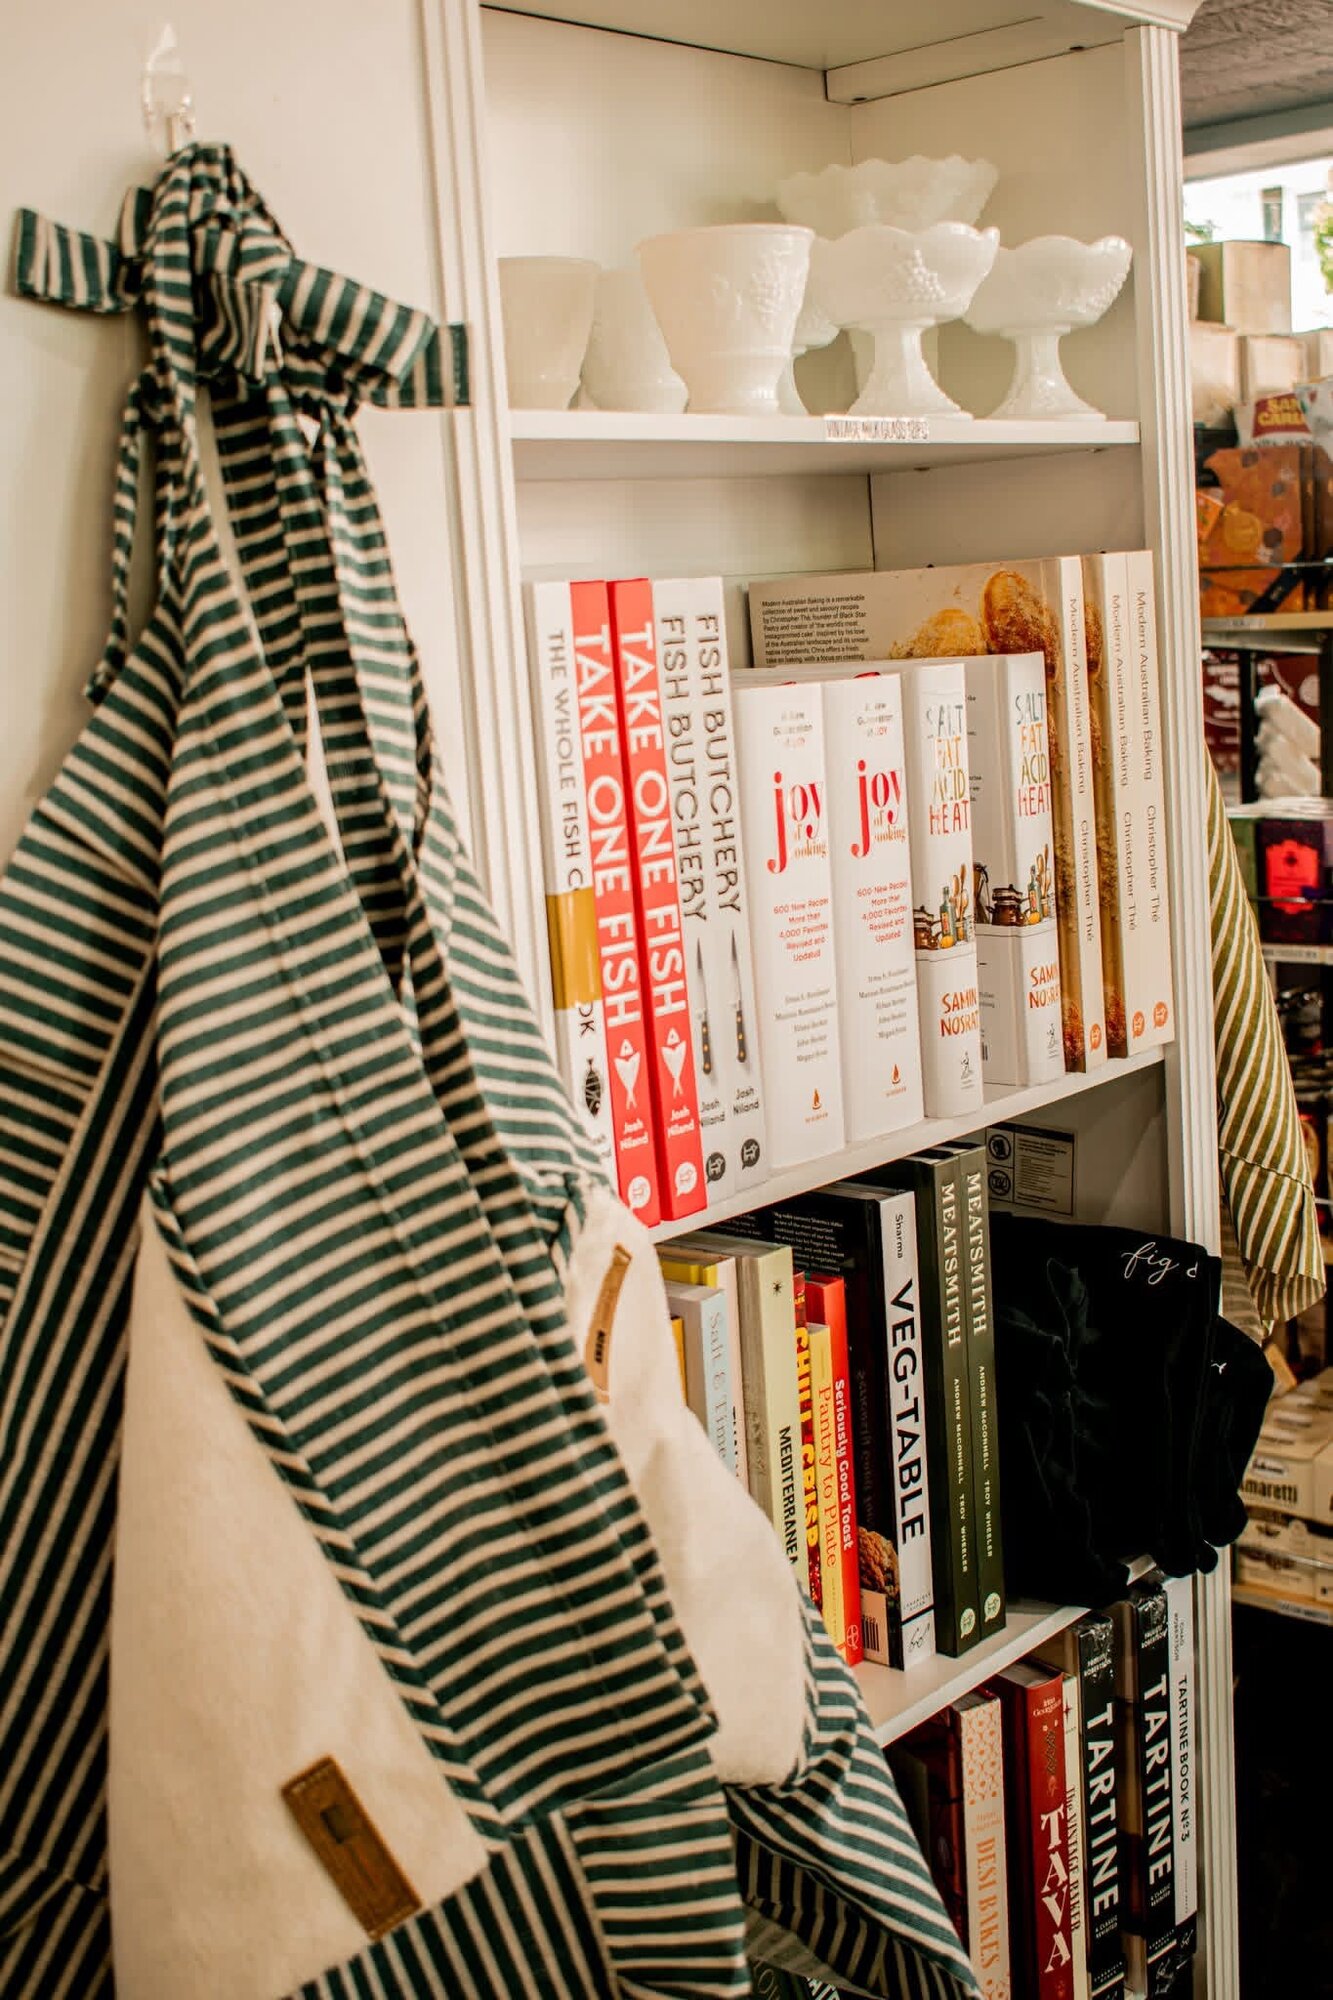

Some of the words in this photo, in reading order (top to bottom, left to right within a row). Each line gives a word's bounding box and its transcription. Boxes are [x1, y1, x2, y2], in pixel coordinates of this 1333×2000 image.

[1069, 598, 1079, 658] Modern
[1112, 594, 1122, 653] Modern
[1136, 591, 1148, 649] Modern
[546, 629, 566, 681] THE
[619, 621, 663, 755] TAKE
[661, 615, 690, 700] FISH
[696, 614, 723, 696] FISH
[574, 624, 619, 759] TAKE
[926, 704, 964, 739] SALT
[1015, 692, 1044, 725] SALT
[1071, 663, 1083, 737] Australian
[1116, 658, 1126, 732] Australian
[1139, 654, 1151, 726] Australian
[552, 688, 577, 791] WHOLE
[1021, 722, 1044, 751] FAT
[1021, 753, 1047, 785] ACID
[1077, 742, 1086, 794] Baking
[1119, 735, 1129, 787] Baking
[1142, 730, 1154, 782] Baking
[562, 801, 581, 858] FISH
[634, 770, 676, 889] ONE
[666, 711, 707, 922] BUTCHERY
[703, 709, 742, 913] BUTCHERY
[767, 771, 824, 875] joy
[851, 759, 902, 859] joy
[929, 800, 969, 835] HEAT
[1018, 783, 1050, 817] HEAT
[587, 775, 630, 897] ONE
[1080, 819, 1091, 907] Christopher
[1123, 811, 1134, 899] Christopher
[1147, 805, 1158, 891] Christopher
[598, 912, 642, 1028] FISH
[646, 903, 686, 1018] FISH
[733, 1101, 759, 1116] Niland
[736, 1087, 755, 1101] Josh
[620, 1133, 649, 1151] Niland
[667, 1120, 695, 1138] Niland
[895, 1213, 904, 1260] Sharma
[966, 1171, 987, 1336] MEATSMITH
[1121, 1241, 1180, 1285] fig
[710, 1311, 724, 1365] Salt
[941, 1182, 961, 1346] MEATSMITH
[956, 1422, 964, 1485] McCONNELL
[835, 1379, 850, 1457] Seriously
[890, 1278, 925, 1545] VEG-TABLE
[979, 1365, 987, 1407] ANDREW
[819, 1386, 834, 1469] Pantry
[981, 1409, 989, 1470] McCONNELL
[778, 1425, 799, 1565] MEDITERRANEA
[823, 1472, 834, 1499] to
[838, 1460, 851, 1503] Good
[824, 1504, 837, 1568] Plate
[841, 1506, 854, 1552] Toast
[1178, 1673, 1189, 1751] TARTINE
[1086, 1702, 1119, 1918] TARTINE
[1143, 1673, 1173, 1886] TARTINE
[1179, 1754, 1190, 1805] BOOK
[976, 1836, 997, 1891] DESI
[1040, 1803, 1071, 1975] TAVA
[978, 1893, 1000, 1970] BAKES
[1069, 1879, 1082, 1933] BAKER
